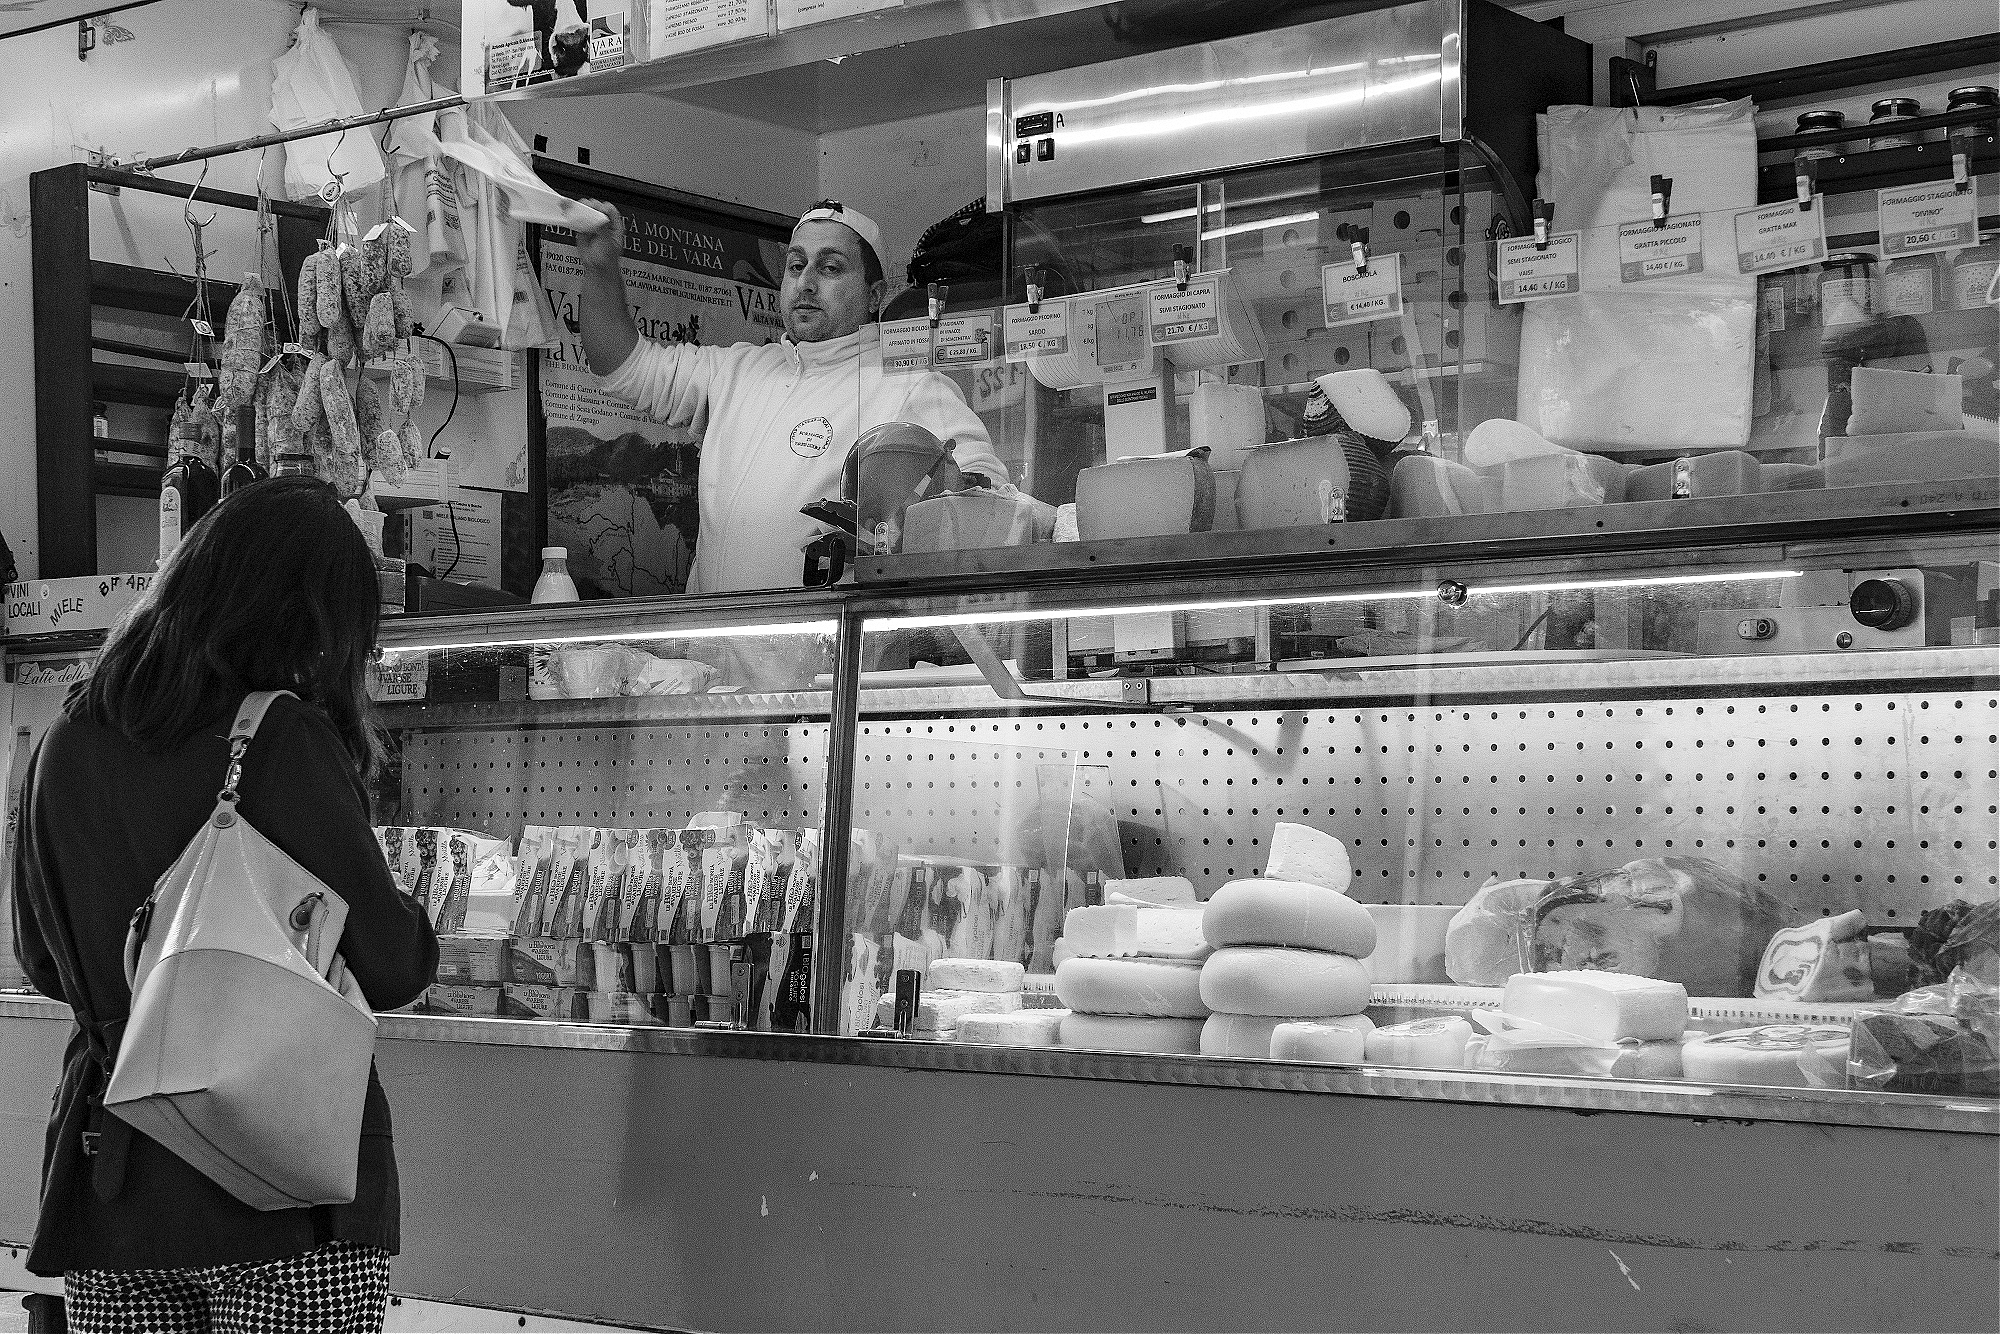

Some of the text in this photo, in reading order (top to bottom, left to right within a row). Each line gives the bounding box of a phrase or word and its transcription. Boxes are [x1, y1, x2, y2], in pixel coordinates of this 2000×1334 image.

[592, 36, 623, 57] VARA
[1056, 113, 1065, 128] A
[1882, 194, 1926, 206] FORMAGGIO
[1620, 226, 1658, 237] FORMAGGIO
[1758, 221, 1797, 235] GRATTA MAX
[645, 221, 725, 252] MONTANA
[1634, 236, 1687, 250] GRATTA PICCOLO
[1906, 234, 1930, 245] 20,60
[647, 240, 677, 261] DEL
[683, 248, 723, 270] VARA
[1555, 280, 1566, 289] KG
[1154, 291, 1186, 301] FORMAGGIO
[1192, 288, 1211, 296] CAPRA
[735, 285, 782, 321] VAR
[1172, 302, 1206, 312] STAGIONATO
[10, 583, 30, 599] VINI
[8, 601, 41, 619] LOCALI
[49, 597, 84, 627] MIELE
[17, 664, 55, 686] Latte
[386, 684, 418, 695] LIGURE
[792, 969, 800, 1002] YOGURT
